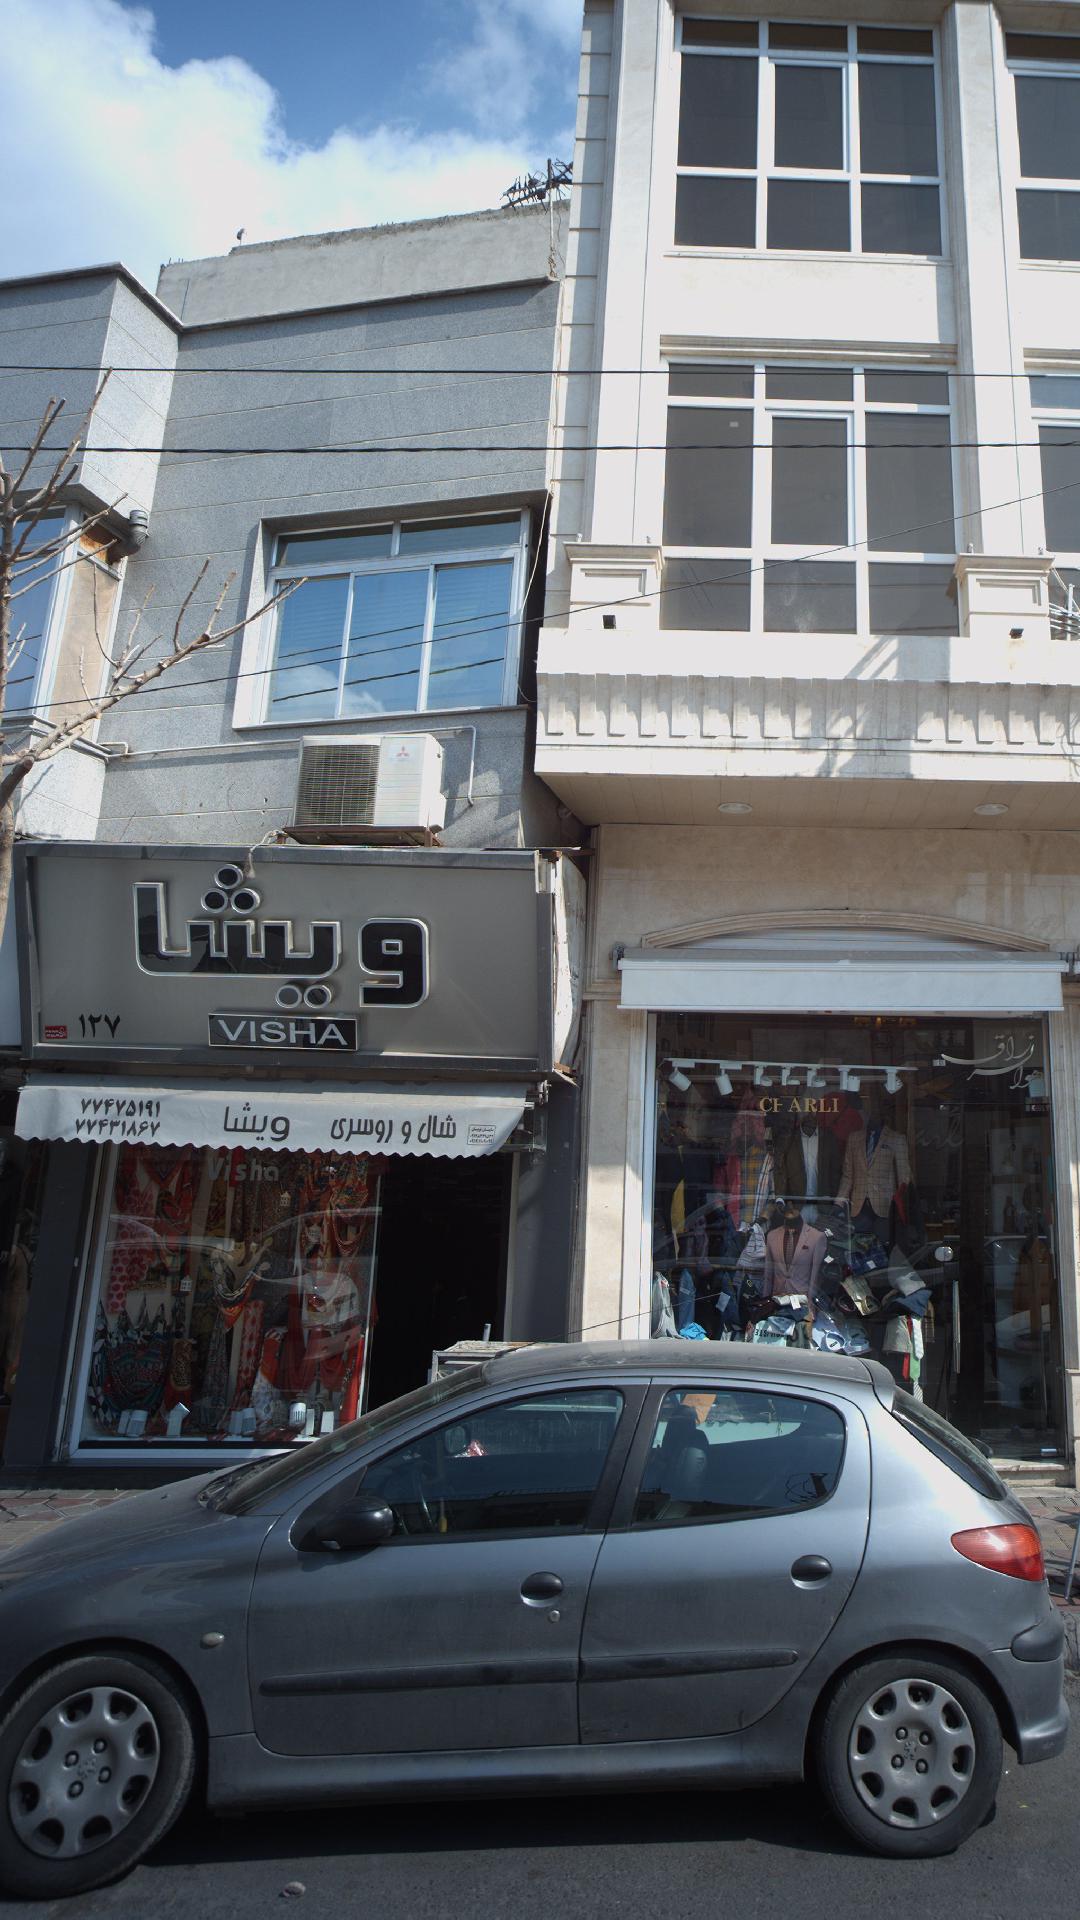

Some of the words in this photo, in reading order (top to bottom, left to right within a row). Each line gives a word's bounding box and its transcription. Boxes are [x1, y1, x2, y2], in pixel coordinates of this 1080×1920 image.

[133, 864, 429, 1008] ویشا
[79, 1013, 121, 1039] ۱۲۷
[217, 1019, 349, 1046] VISHA
[80, 1098, 161, 1118] ۷۷۴۷۵۱۹۱
[75, 1118, 161, 1137] ۷۷۴۳۱۸۶۷
[223, 1102, 290, 1142] ویشا
[331, 1117, 394, 1144] روسری
[401, 1120, 413, 1144] و
[417, 1114, 457, 1144] شال
[207, 1154, 280, 1182] Visha
